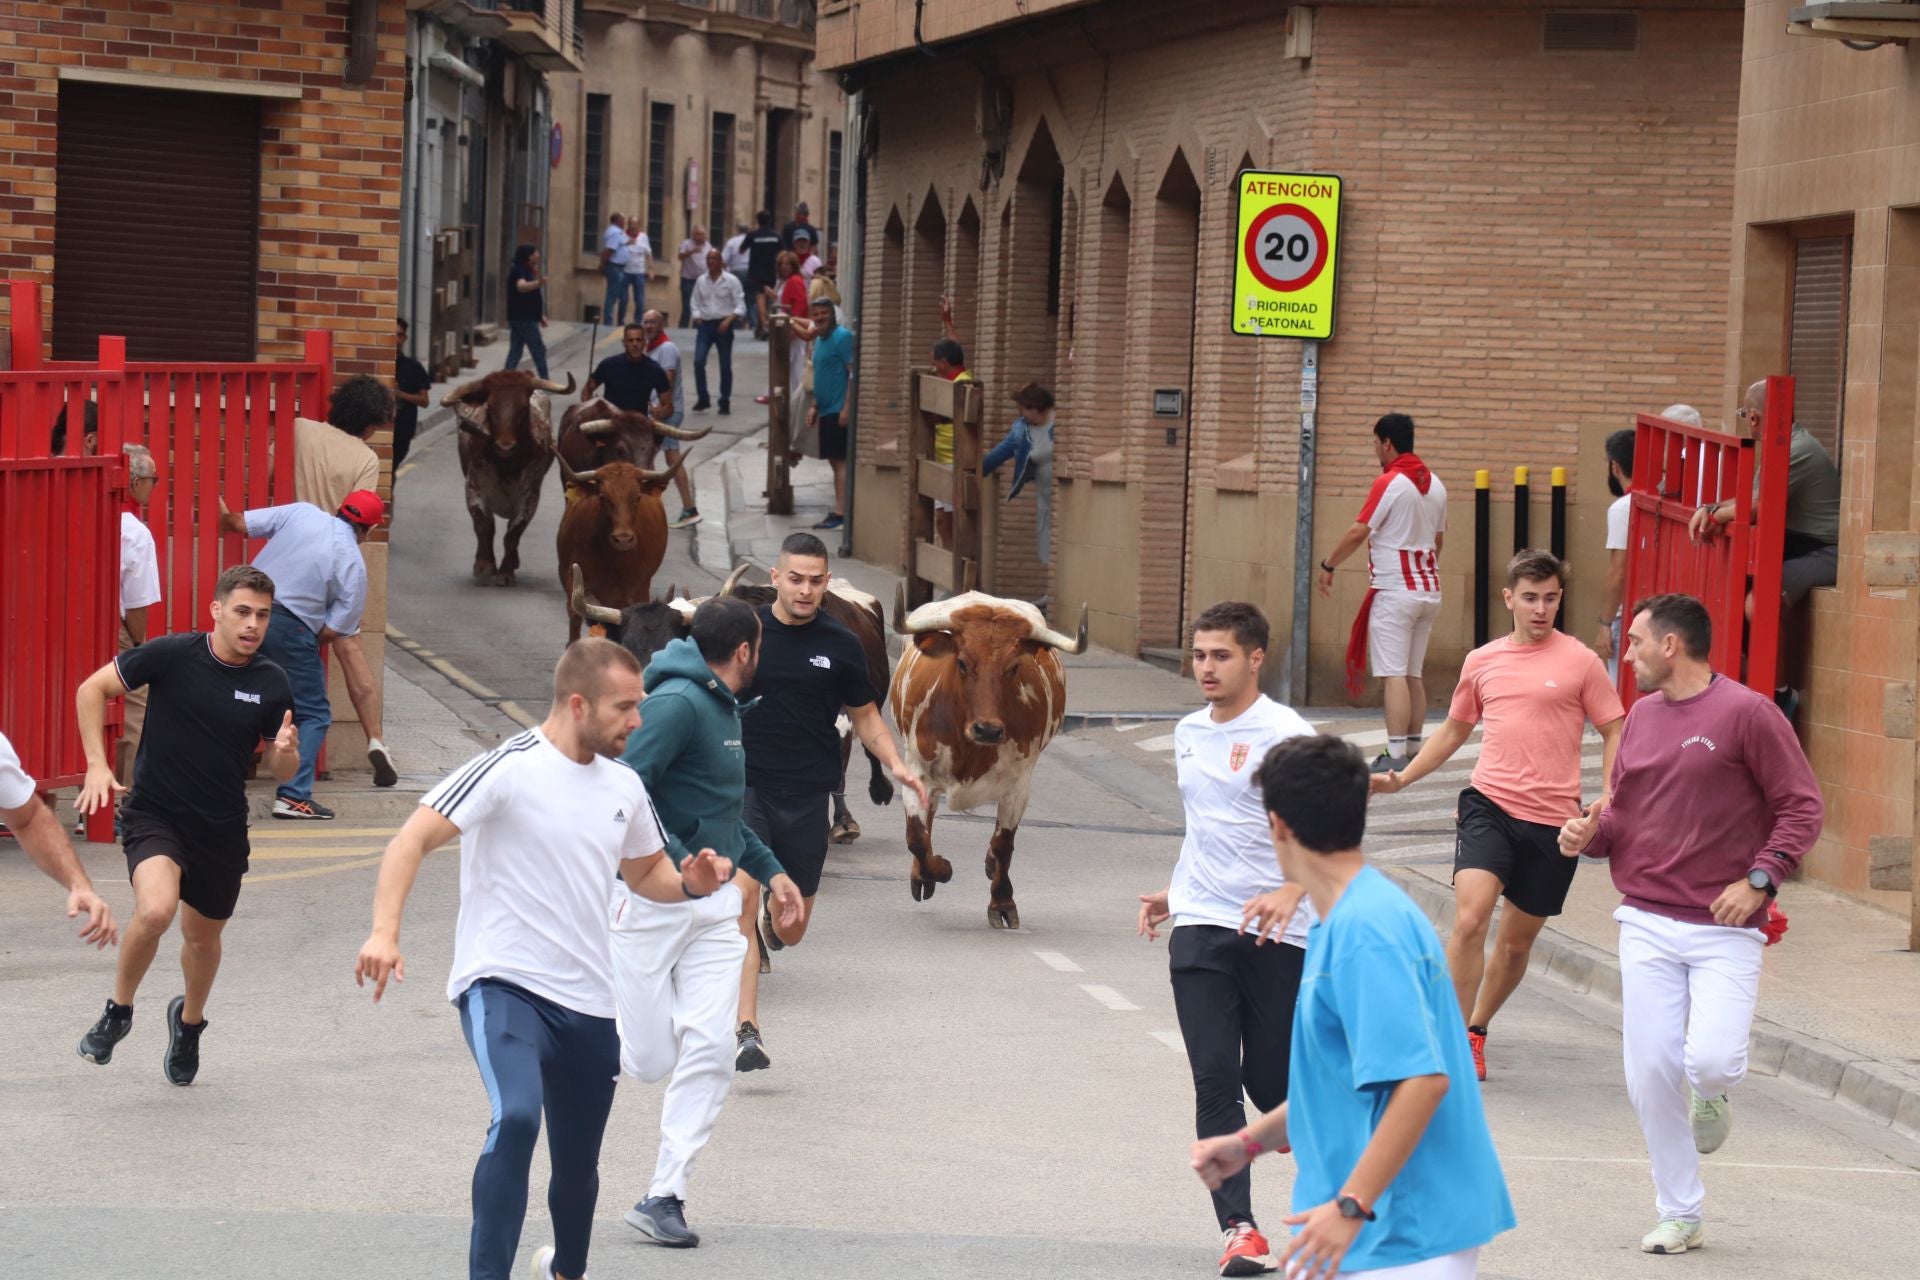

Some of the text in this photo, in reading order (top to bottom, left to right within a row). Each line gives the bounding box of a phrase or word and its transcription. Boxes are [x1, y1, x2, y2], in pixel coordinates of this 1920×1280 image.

[1246, 181, 1333, 199] ATENCIÓN
[1264, 232, 1309, 262] 20
[1248, 300, 1318, 314] PRIORIDAD
[1249, 316, 1315, 330] PEATONAL
